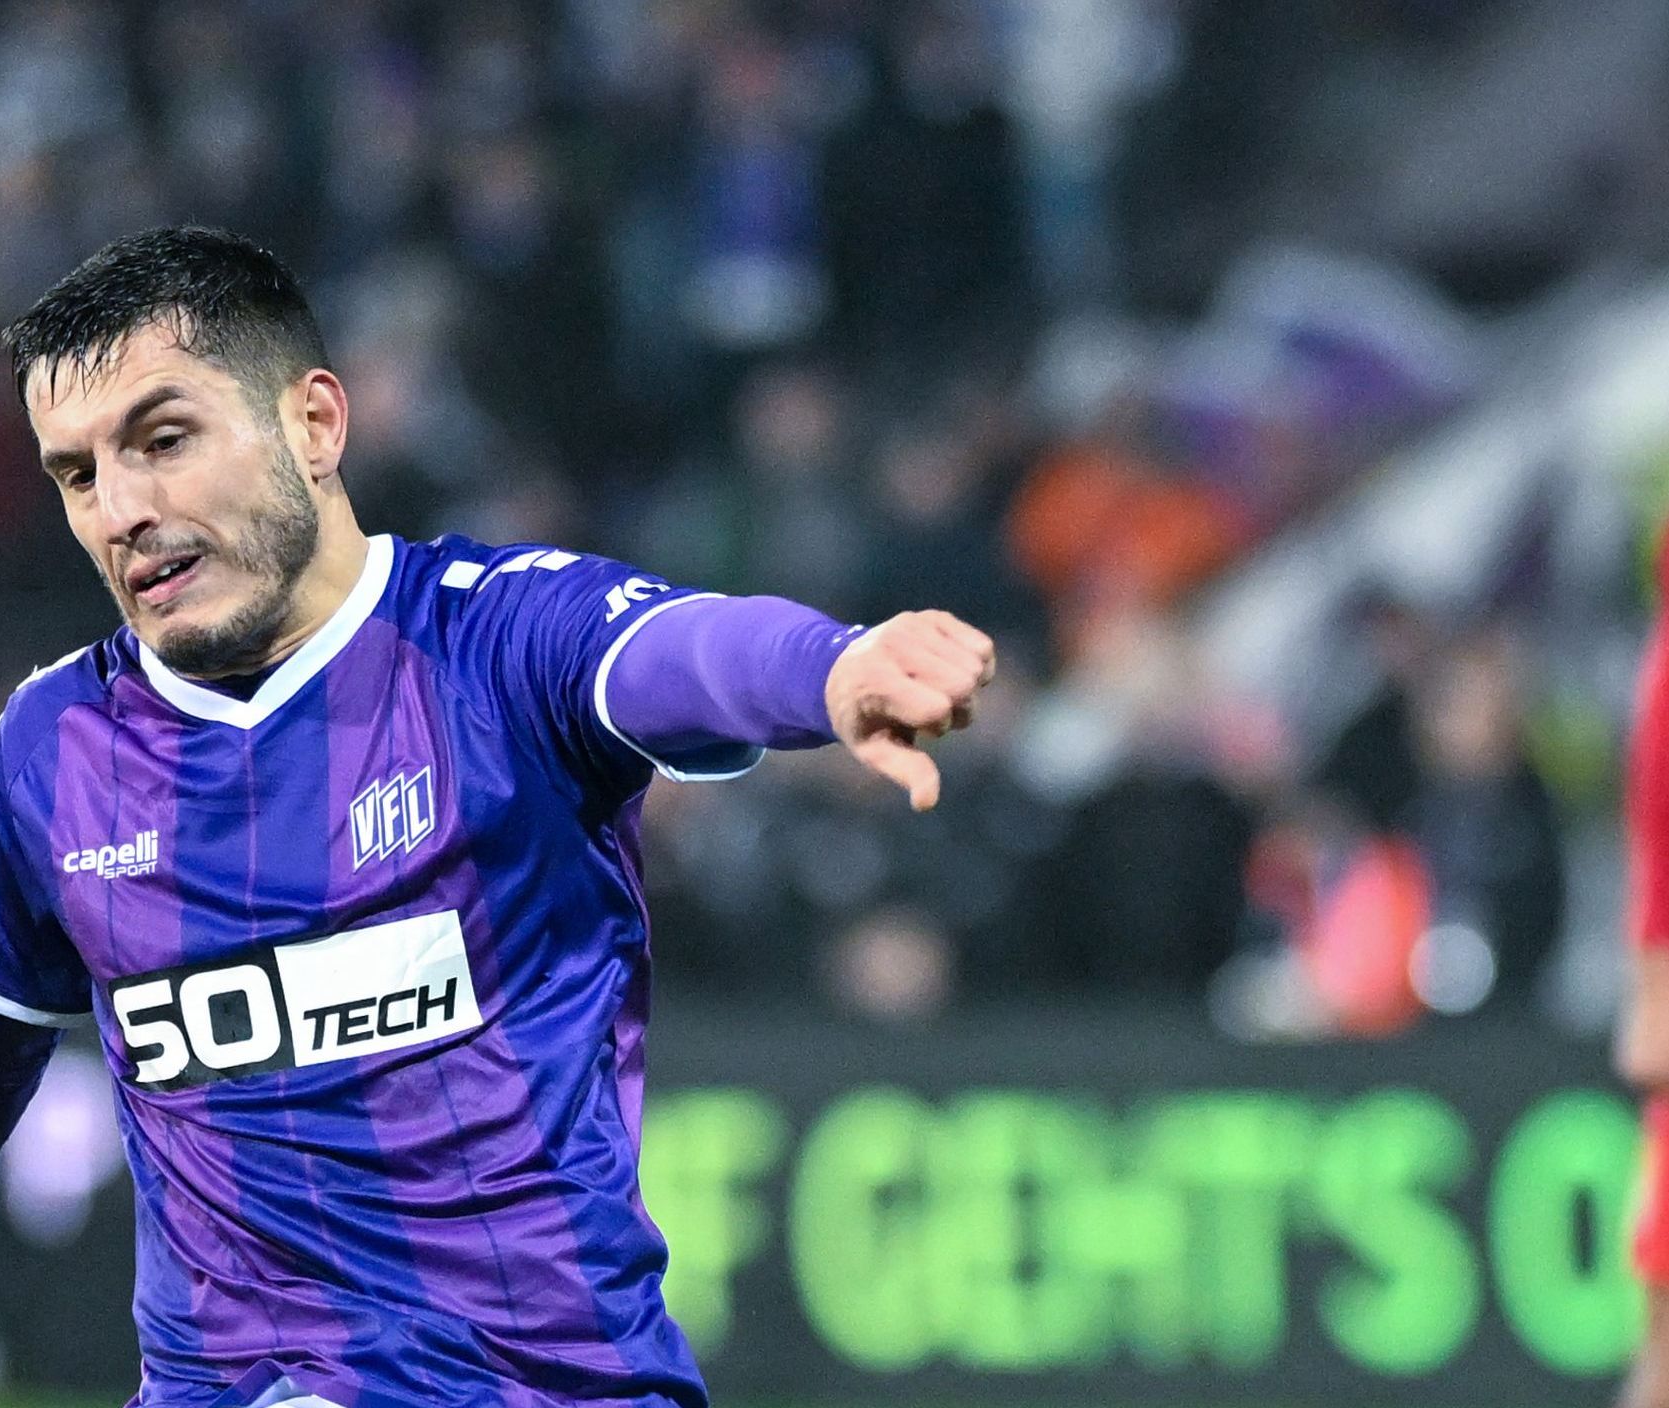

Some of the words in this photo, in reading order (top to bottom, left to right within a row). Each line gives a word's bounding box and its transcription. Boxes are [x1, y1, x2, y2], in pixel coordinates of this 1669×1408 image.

[352, 780, 431, 858] VFL
[63, 829, 159, 877] capelli
[103, 860, 159, 880] SPORT
[302, 976, 458, 1052] TECH
